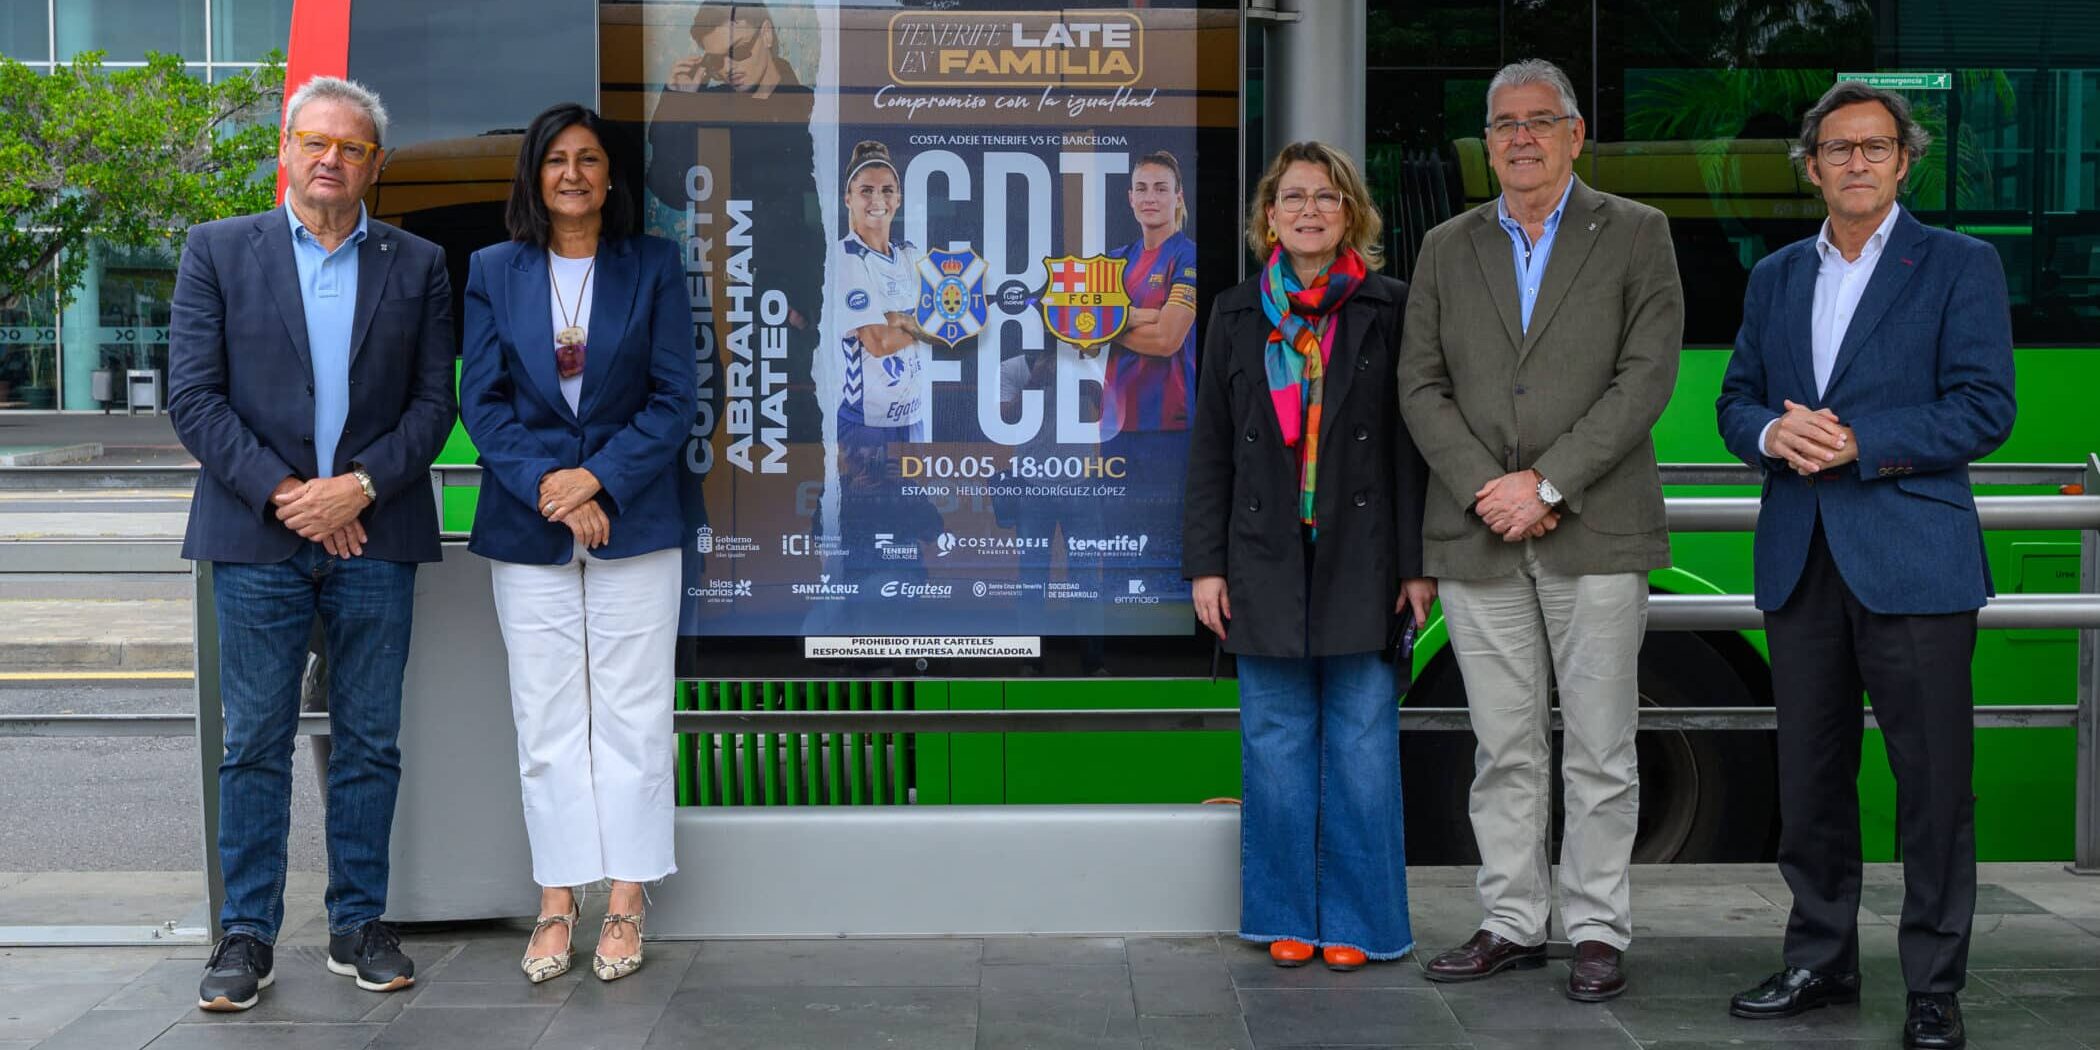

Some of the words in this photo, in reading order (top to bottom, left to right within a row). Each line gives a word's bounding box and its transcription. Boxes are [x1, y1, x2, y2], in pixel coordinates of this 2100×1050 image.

[900, 23, 1004, 47] TENERIFE
[1012, 22, 1131, 48] LATE
[899, 51, 934, 73] EN
[939, 49, 1135, 75] FAMILIA
[873, 84, 986, 120] Compromiso
[994, 96, 1031, 109] con
[1037, 85, 1061, 112] la
[1066, 86, 1158, 117] igualdad
[909, 135, 947, 146] COSTA
[949, 135, 981, 146] ADEJE
[982, 135, 1028, 146] TENERIFE
[1030, 135, 1045, 146] VS
[1046, 135, 1061, 146] FC
[1062, 135, 1128, 147] BARCELONA
[904, 150, 1129, 296] CDT
[686, 165, 714, 475] CONCIERTO
[726, 200, 753, 474] ABRAHAM
[760, 289, 788, 474] MATEO
[902, 486, 949, 496] ESTADIO
[1025, 484, 1090, 496] RODRÍGUEZ
[1093, 484, 1126, 496] LÓPEZ
[715, 535, 752, 543] Gobierno
[726, 543, 761, 551] Canarias
[709, 579, 734, 588] Islas
[687, 587, 734, 596] Canarias
[900, 582, 953, 598] Egatesa
[1114, 595, 1159, 604] emmasa
[852, 638, 910, 646] PROHIBIDO
[913, 638, 941, 646] FIJAR
[944, 638, 994, 646] CARTELES
[812, 648, 886, 656] RESPONSABLE
[957, 647, 1033, 655] ANUNCIADORA
